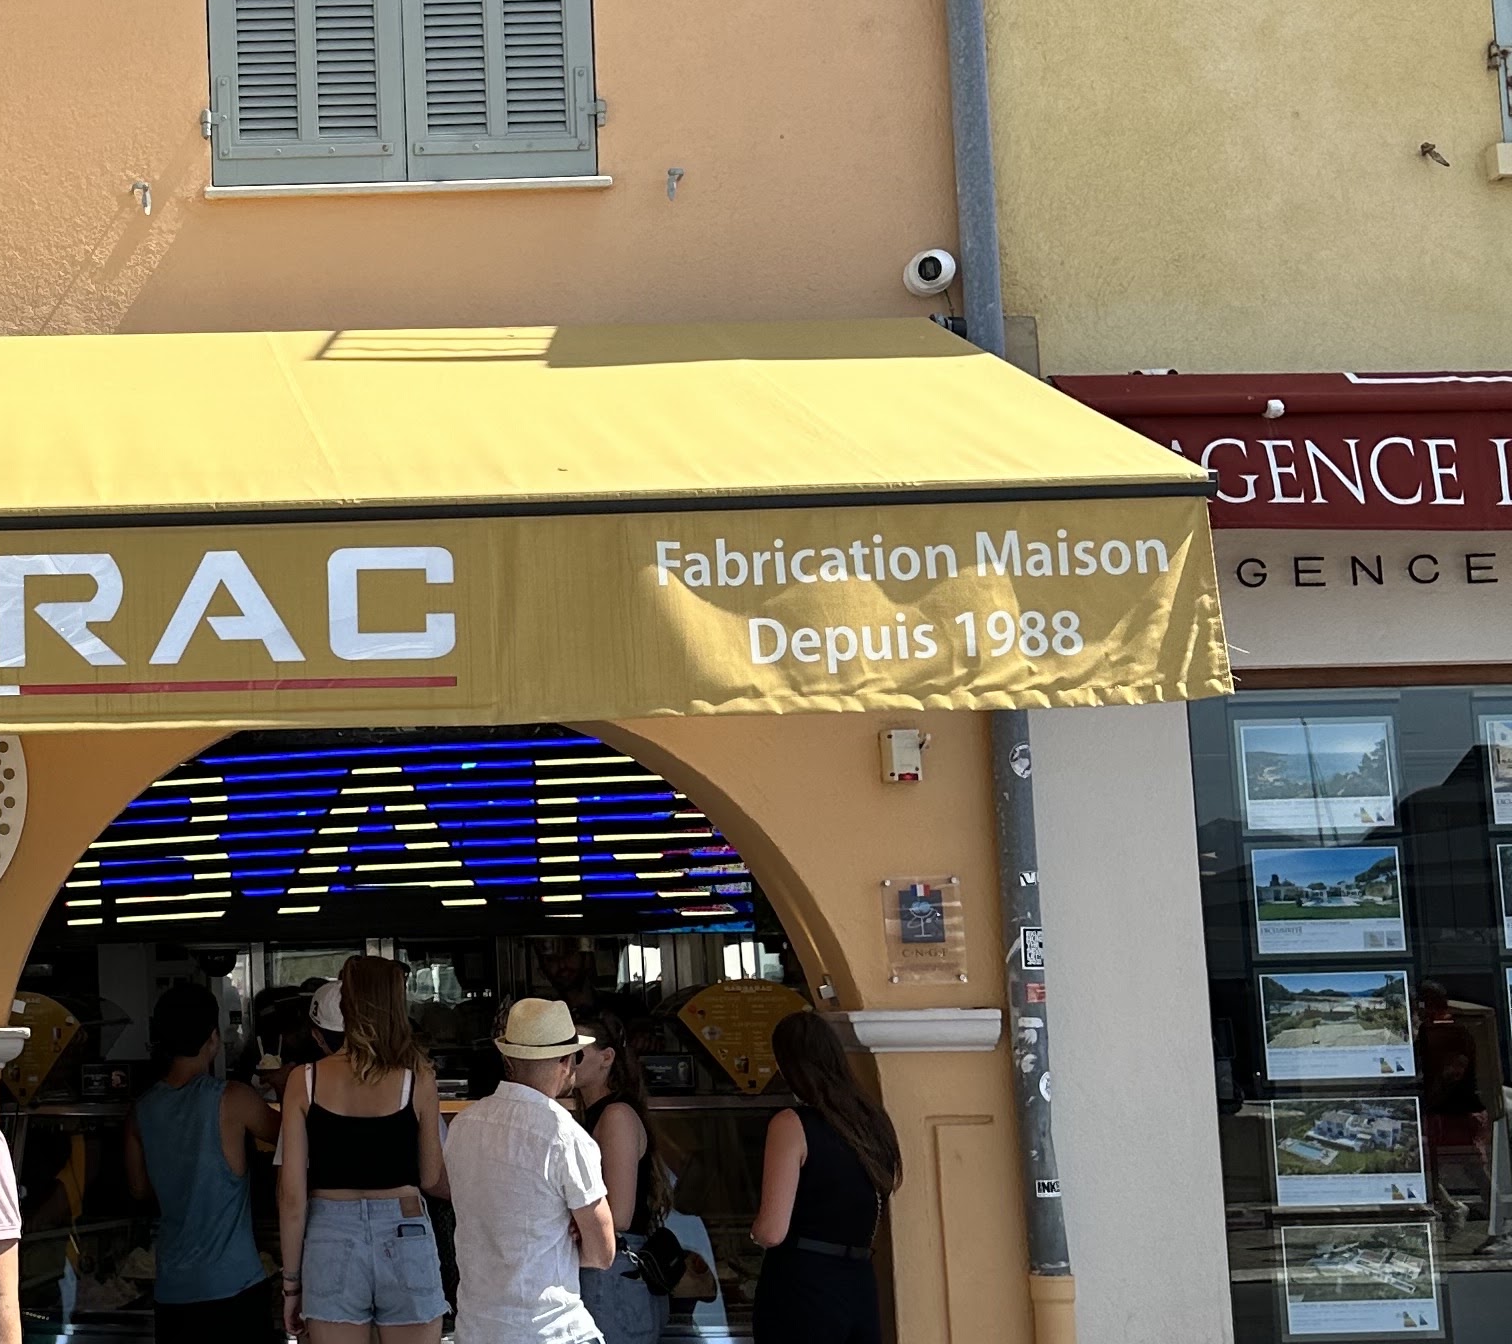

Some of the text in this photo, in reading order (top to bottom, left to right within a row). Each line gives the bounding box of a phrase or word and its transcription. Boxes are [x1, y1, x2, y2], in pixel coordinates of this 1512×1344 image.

[1171, 436, 1465, 505] GENCE
[655, 529, 1170, 587] Fabrication Maison
[748, 610, 1084, 673] Depuis 1988
